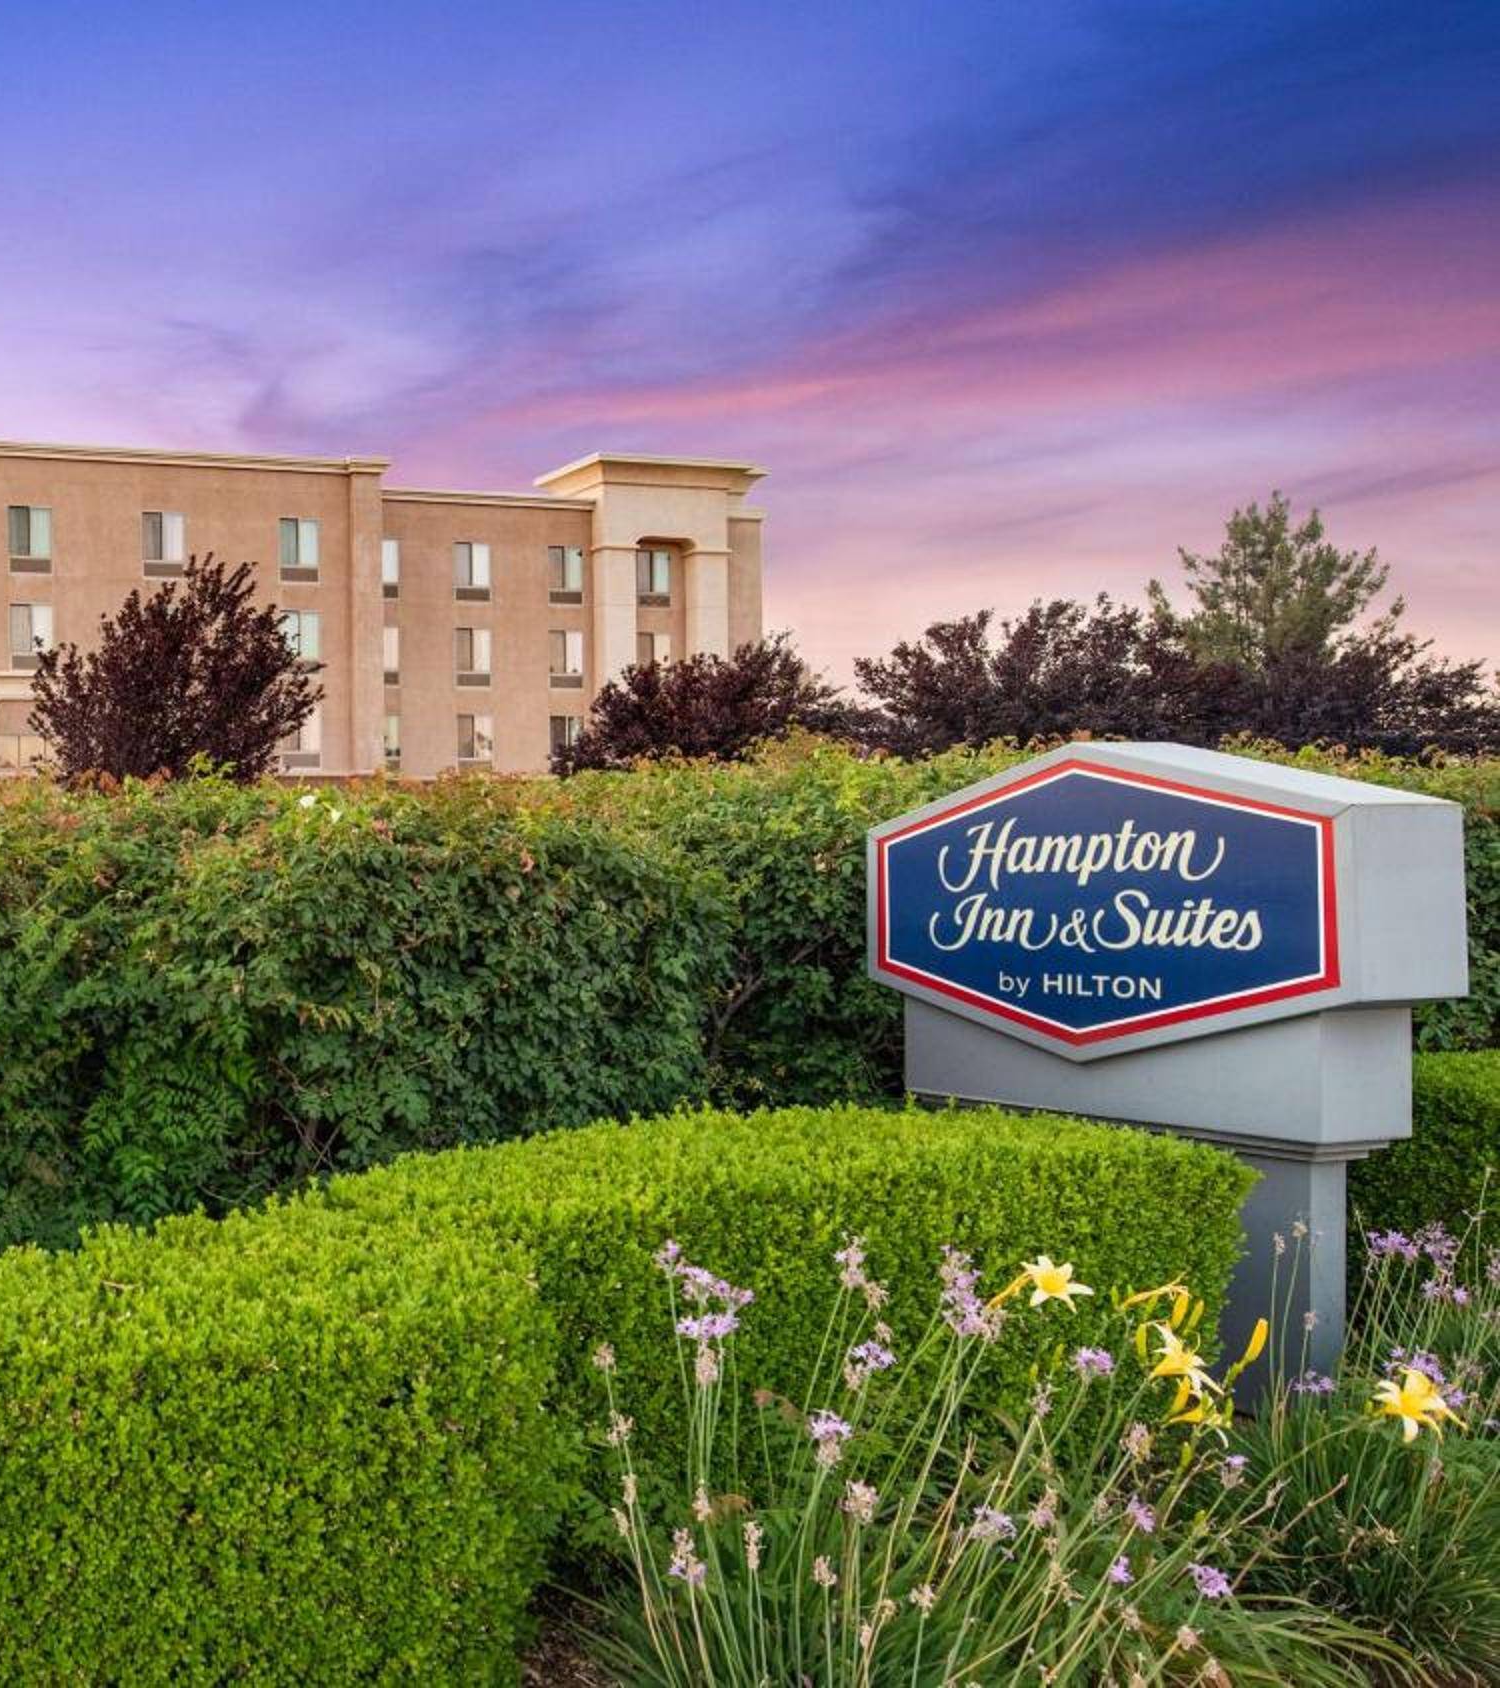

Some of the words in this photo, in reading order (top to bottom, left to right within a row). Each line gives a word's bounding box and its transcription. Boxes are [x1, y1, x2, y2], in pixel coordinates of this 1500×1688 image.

[938, 817, 1225, 893] Hampton
[929, 892, 1059, 951] Inn
[1060, 909, 1096, 953] &
[1093, 889, 1263, 952] Suites
[999, 971, 1031, 998] by
[1042, 972, 1162, 1000] HILTON
